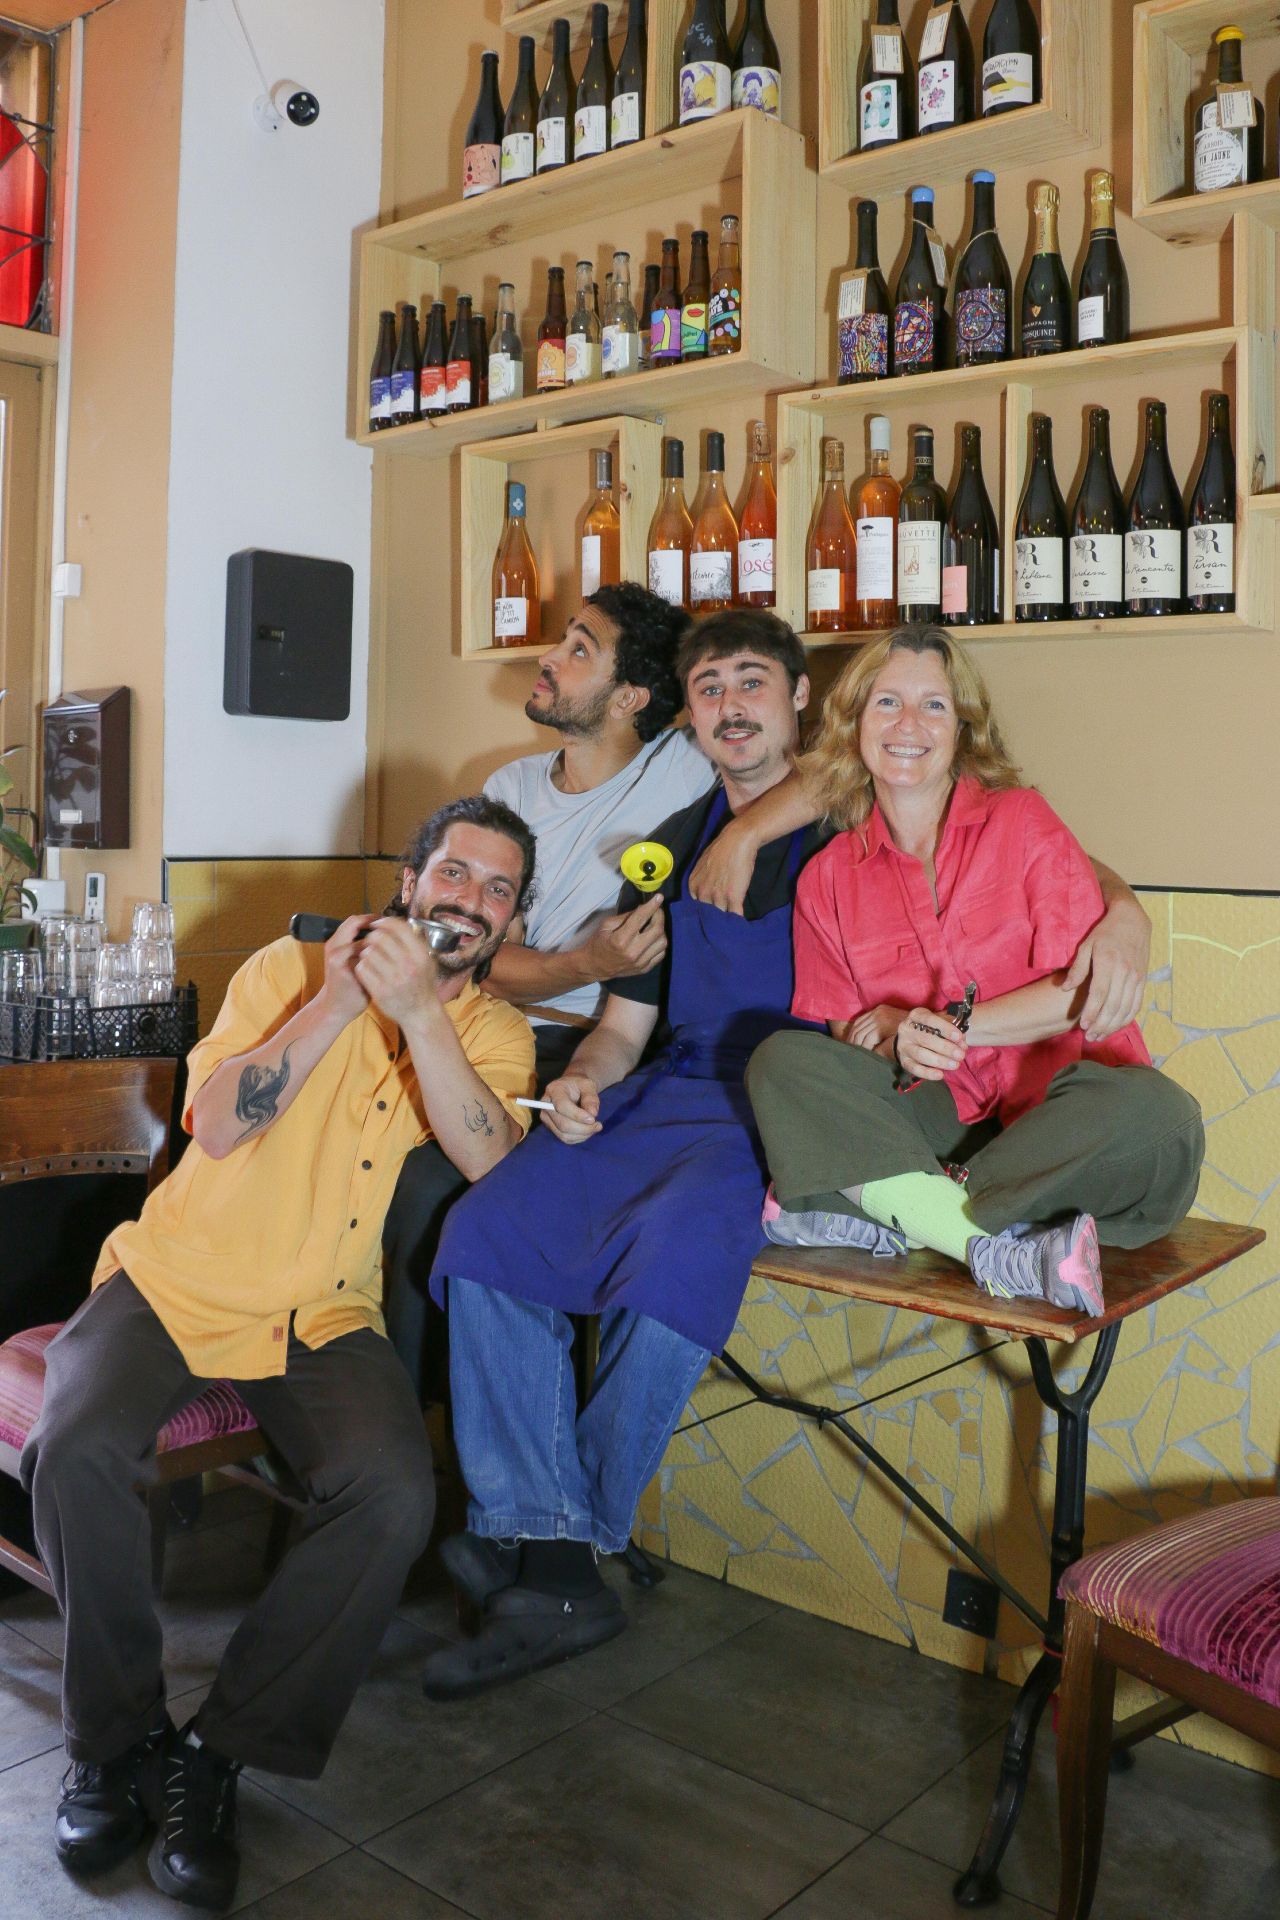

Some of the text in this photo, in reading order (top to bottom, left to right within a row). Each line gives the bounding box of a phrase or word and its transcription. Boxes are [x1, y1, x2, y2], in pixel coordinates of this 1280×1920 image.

[1199, 150, 1231, 166] VIN JAUNE
[900, 530, 936, 538] UVETTE
[741, 552, 773, 573] osé
[1131, 562, 1176, 574] Rencontre
[1192, 555, 1228, 569] Persan
